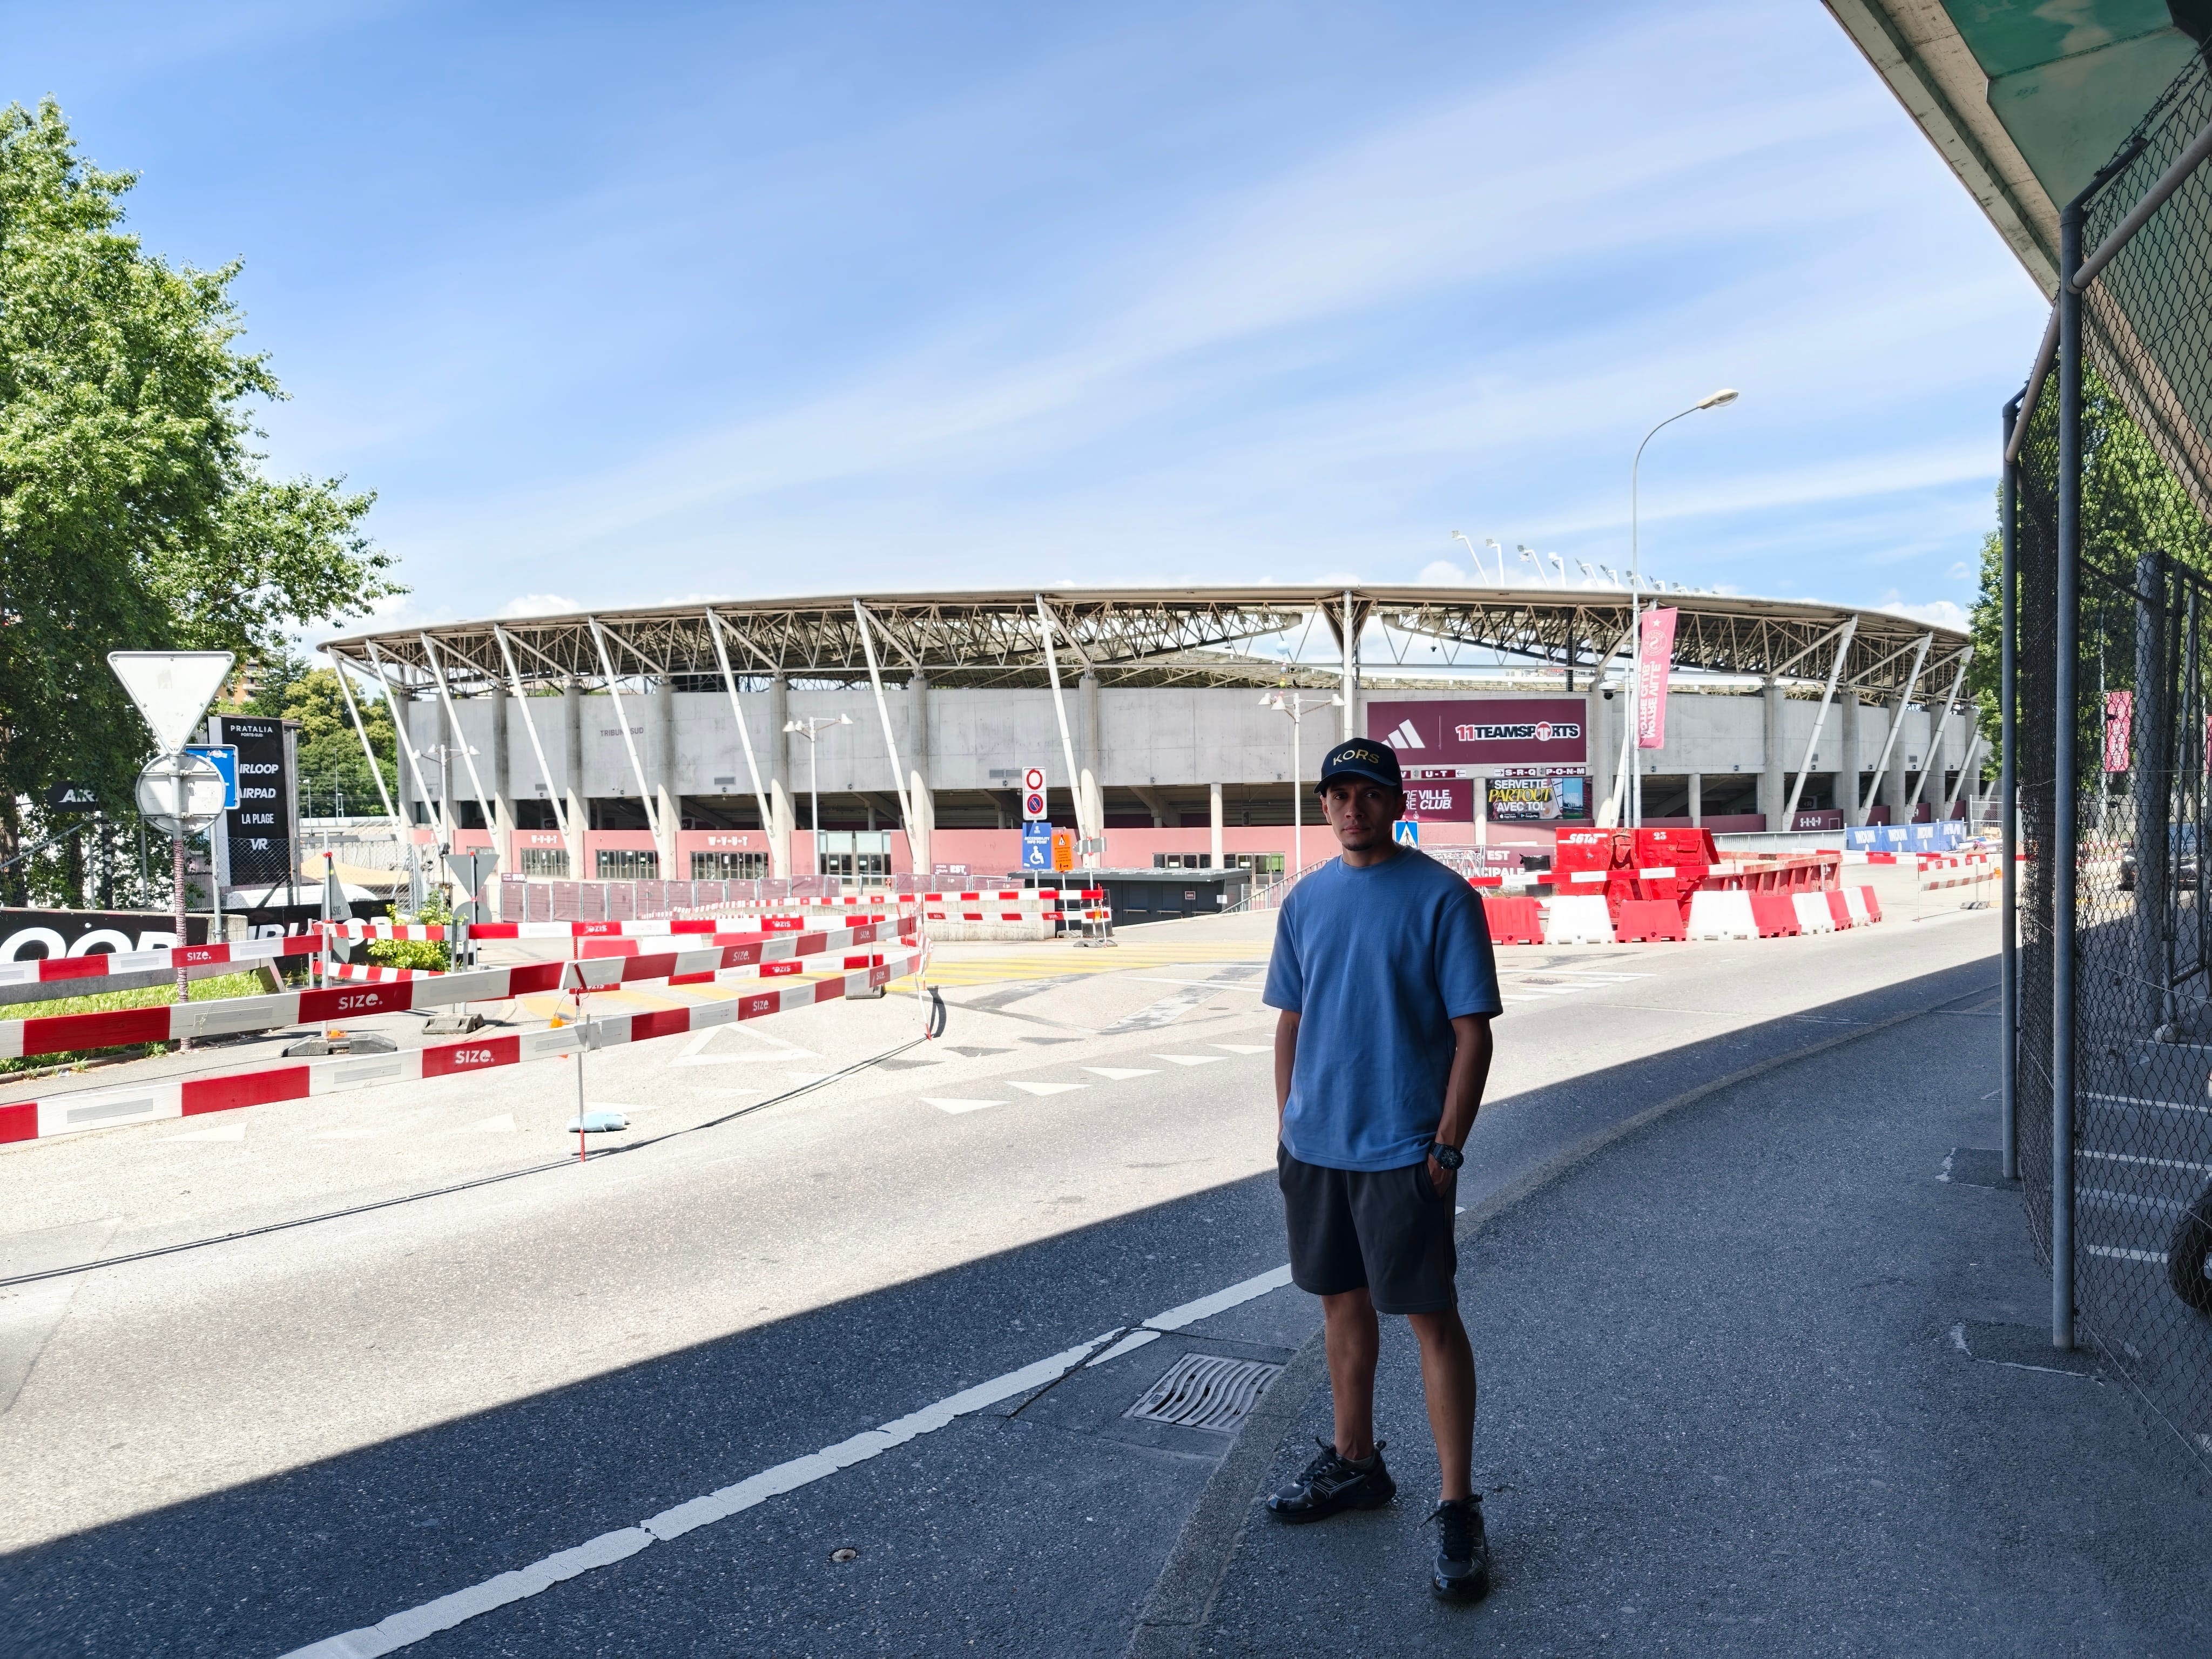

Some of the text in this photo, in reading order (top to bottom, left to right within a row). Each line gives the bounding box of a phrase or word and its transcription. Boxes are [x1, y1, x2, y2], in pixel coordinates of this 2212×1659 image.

[230, 725, 273, 733] PRATALIA
[600, 729, 624, 737] TRIBUN
[1333, 749, 1380, 766] KORS
[239, 764, 279, 774] IRLOOP
[1494, 779, 1548, 789] SERVETTE
[1488, 788, 1553, 802] PARTOUT
[1496, 801, 1546, 812] AVEC TOI.
[241, 813, 274, 824] LA PLAGE
[251, 838, 268, 850] VR
[1487, 850, 1510, 860] EST
